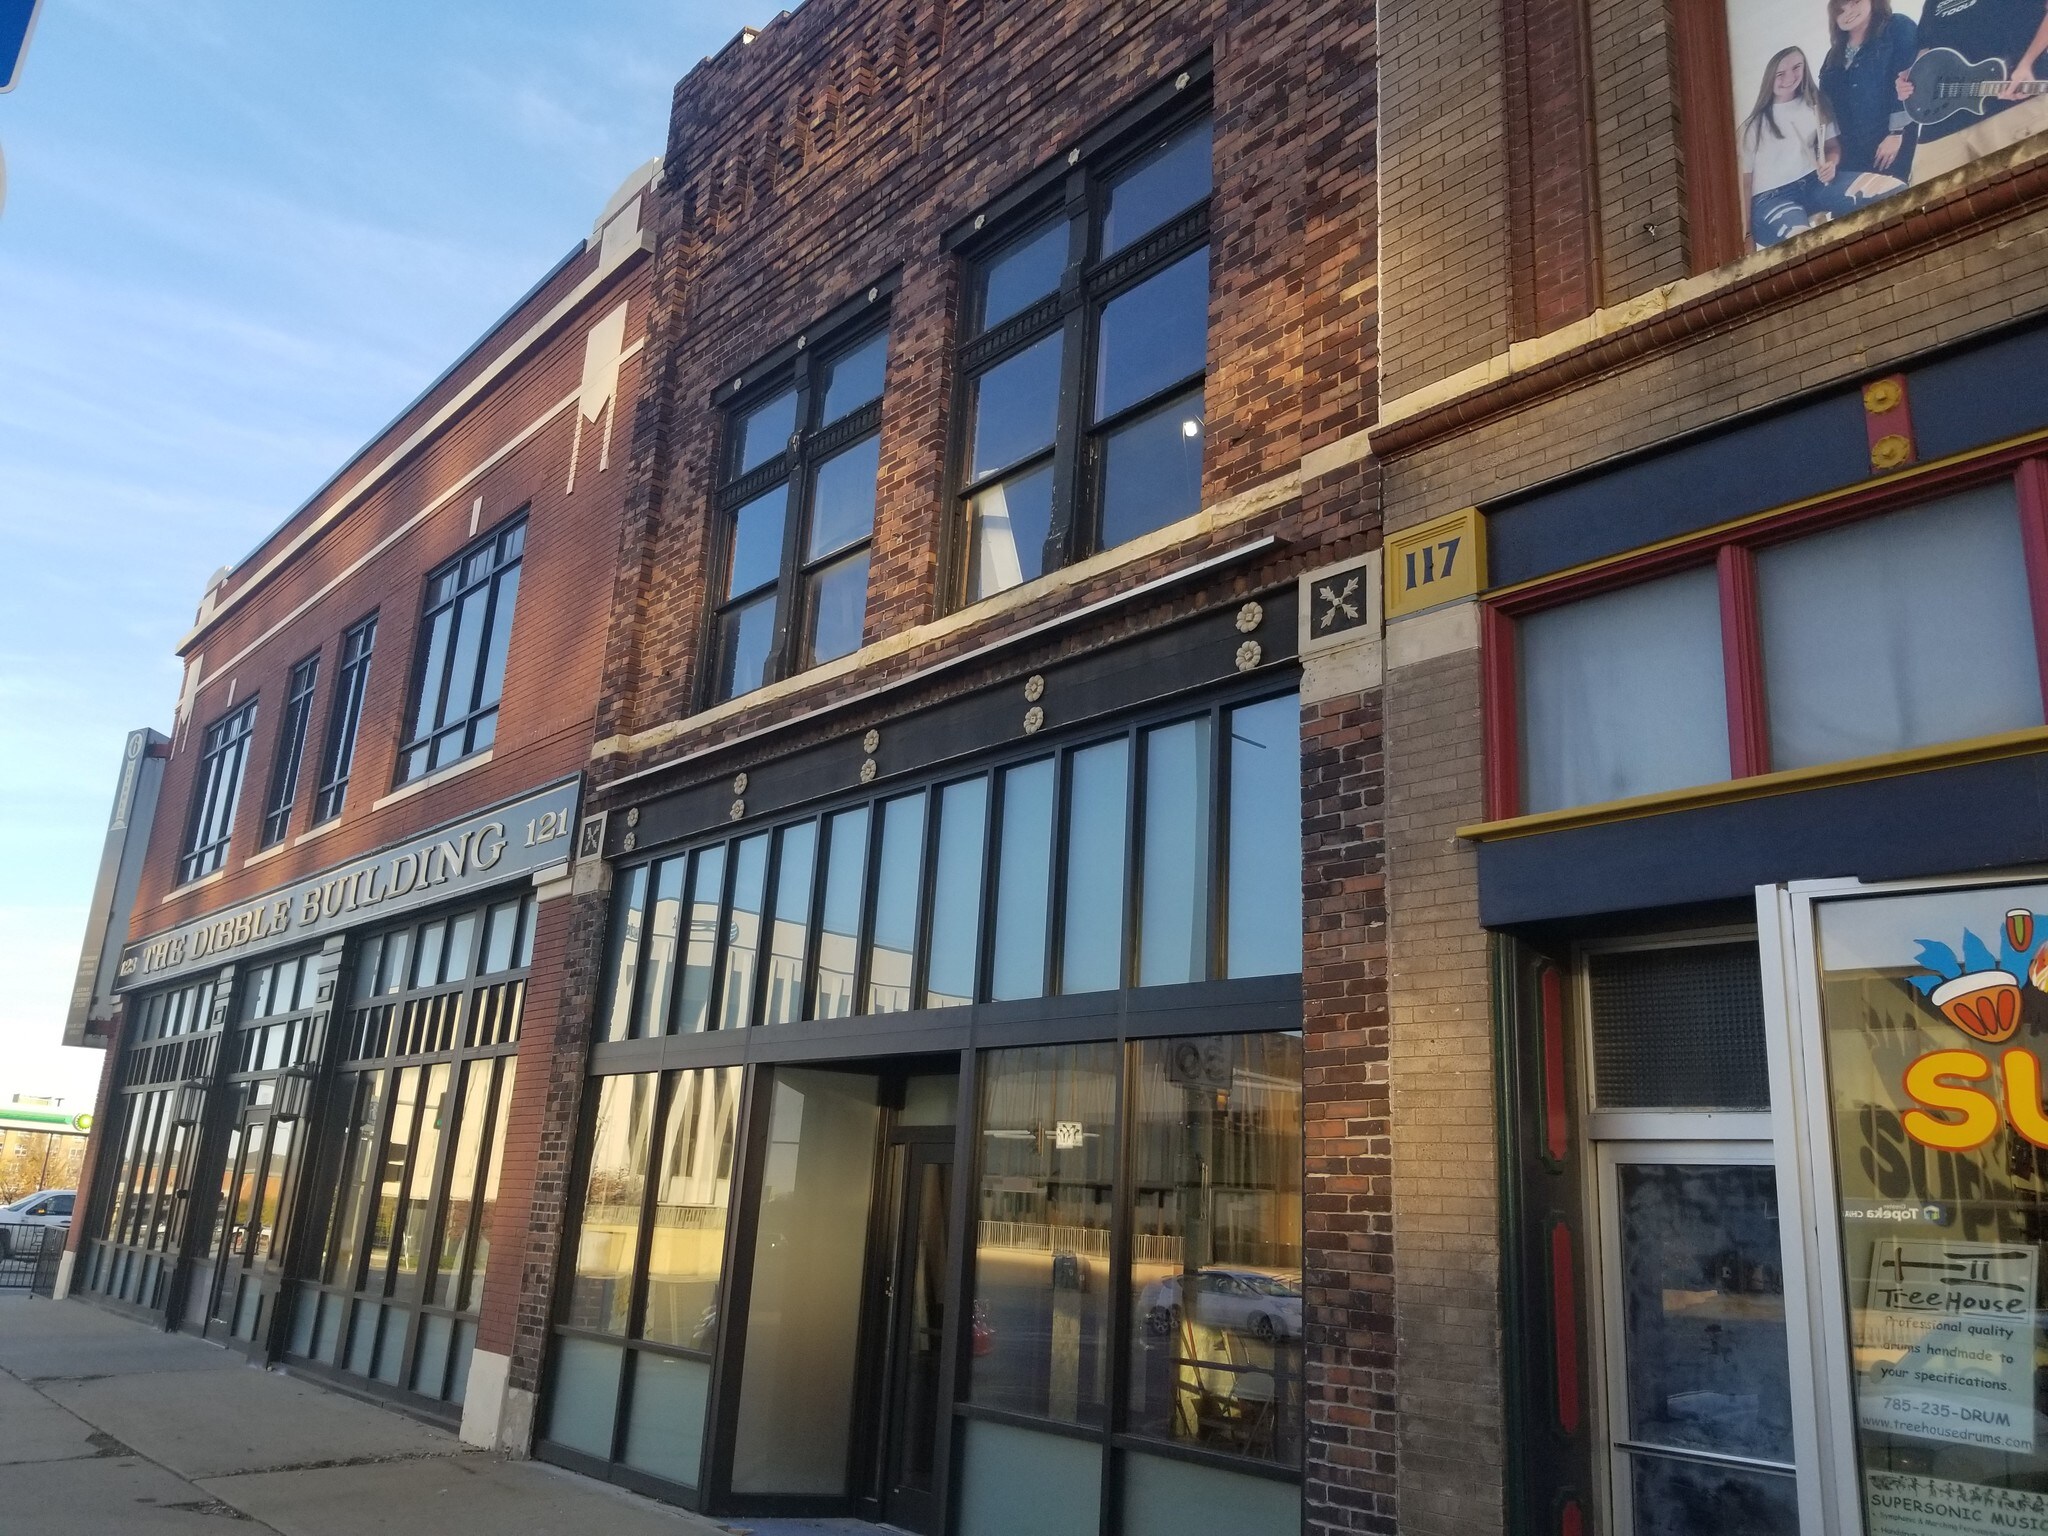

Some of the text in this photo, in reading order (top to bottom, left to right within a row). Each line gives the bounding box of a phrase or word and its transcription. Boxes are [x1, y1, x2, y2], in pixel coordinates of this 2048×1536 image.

[1405, 536, 1462, 591] 117
[142, 934, 188, 975] THE
[188, 897, 292, 961] DIBBLE
[298, 822, 507, 927] BUILDING
[524, 807, 568, 847] 121
[1885, 1316, 2013, 1340] Professional quality
[1883, 1341, 2013, 1364] drums handmade to
[1881, 1367, 2012, 1392] your specifications.
[1883, 1397, 2011, 1427] 785-235-DRUM
[1862, 1415, 2032, 1450] www.treehousedrums.com
[1871, 1494, 2048, 1532] SUPERSONIC MUSIC
